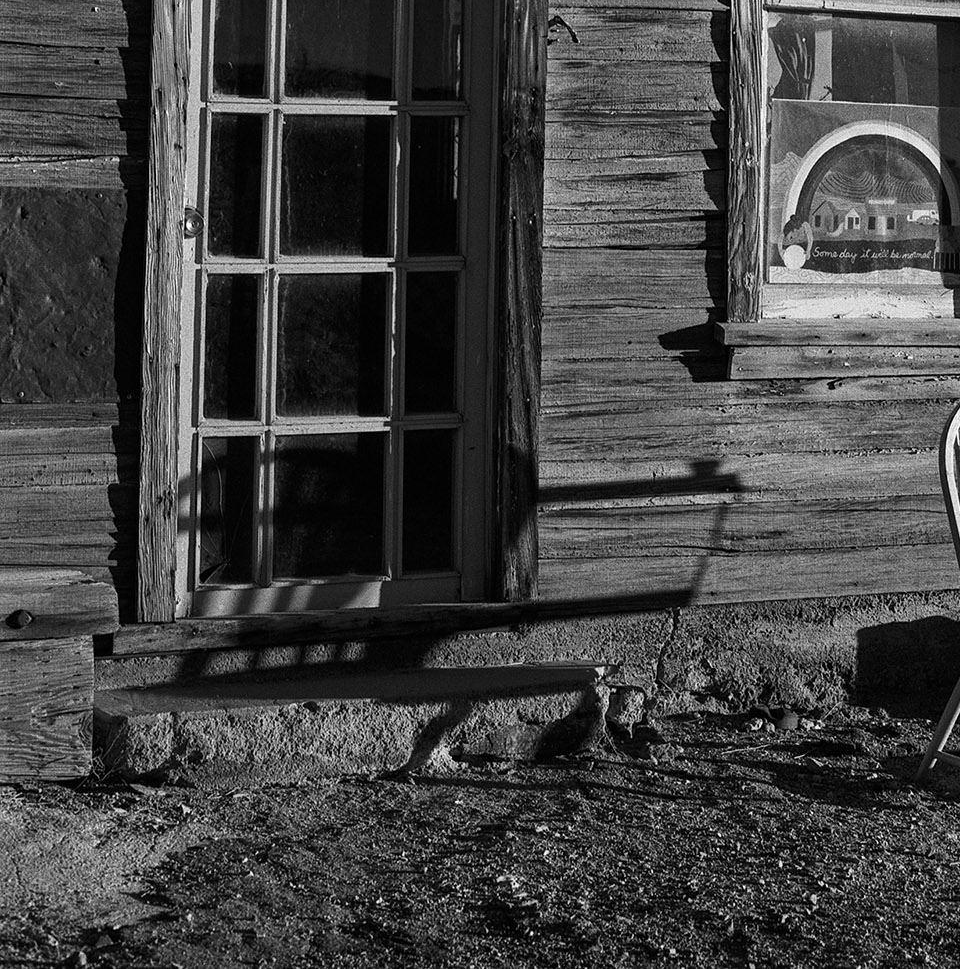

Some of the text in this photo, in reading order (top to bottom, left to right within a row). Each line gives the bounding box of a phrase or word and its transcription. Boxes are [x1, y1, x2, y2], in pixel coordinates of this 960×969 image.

[860, 246, 871, 259] it
[871, 248, 889, 259] will
[890, 248, 901, 259] be
